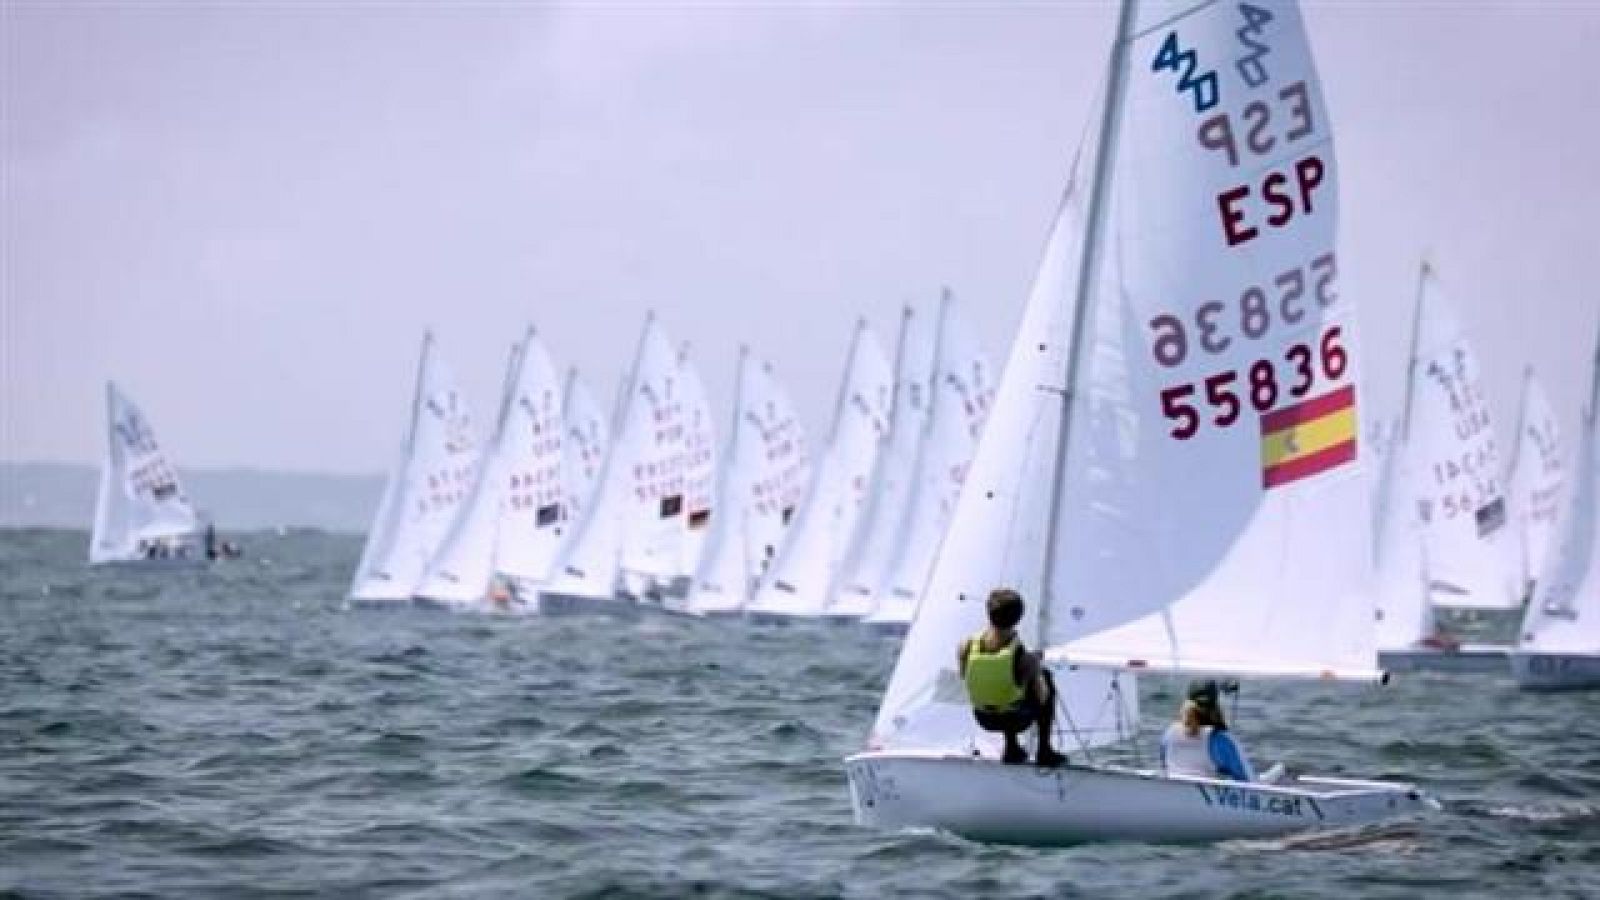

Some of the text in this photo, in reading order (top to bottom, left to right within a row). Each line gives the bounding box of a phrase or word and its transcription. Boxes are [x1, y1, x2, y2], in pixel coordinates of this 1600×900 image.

[1151, 29, 1220, 113] 420
[1217, 156, 1325, 247] ESP
[1160, 326, 1347, 440] 55836
